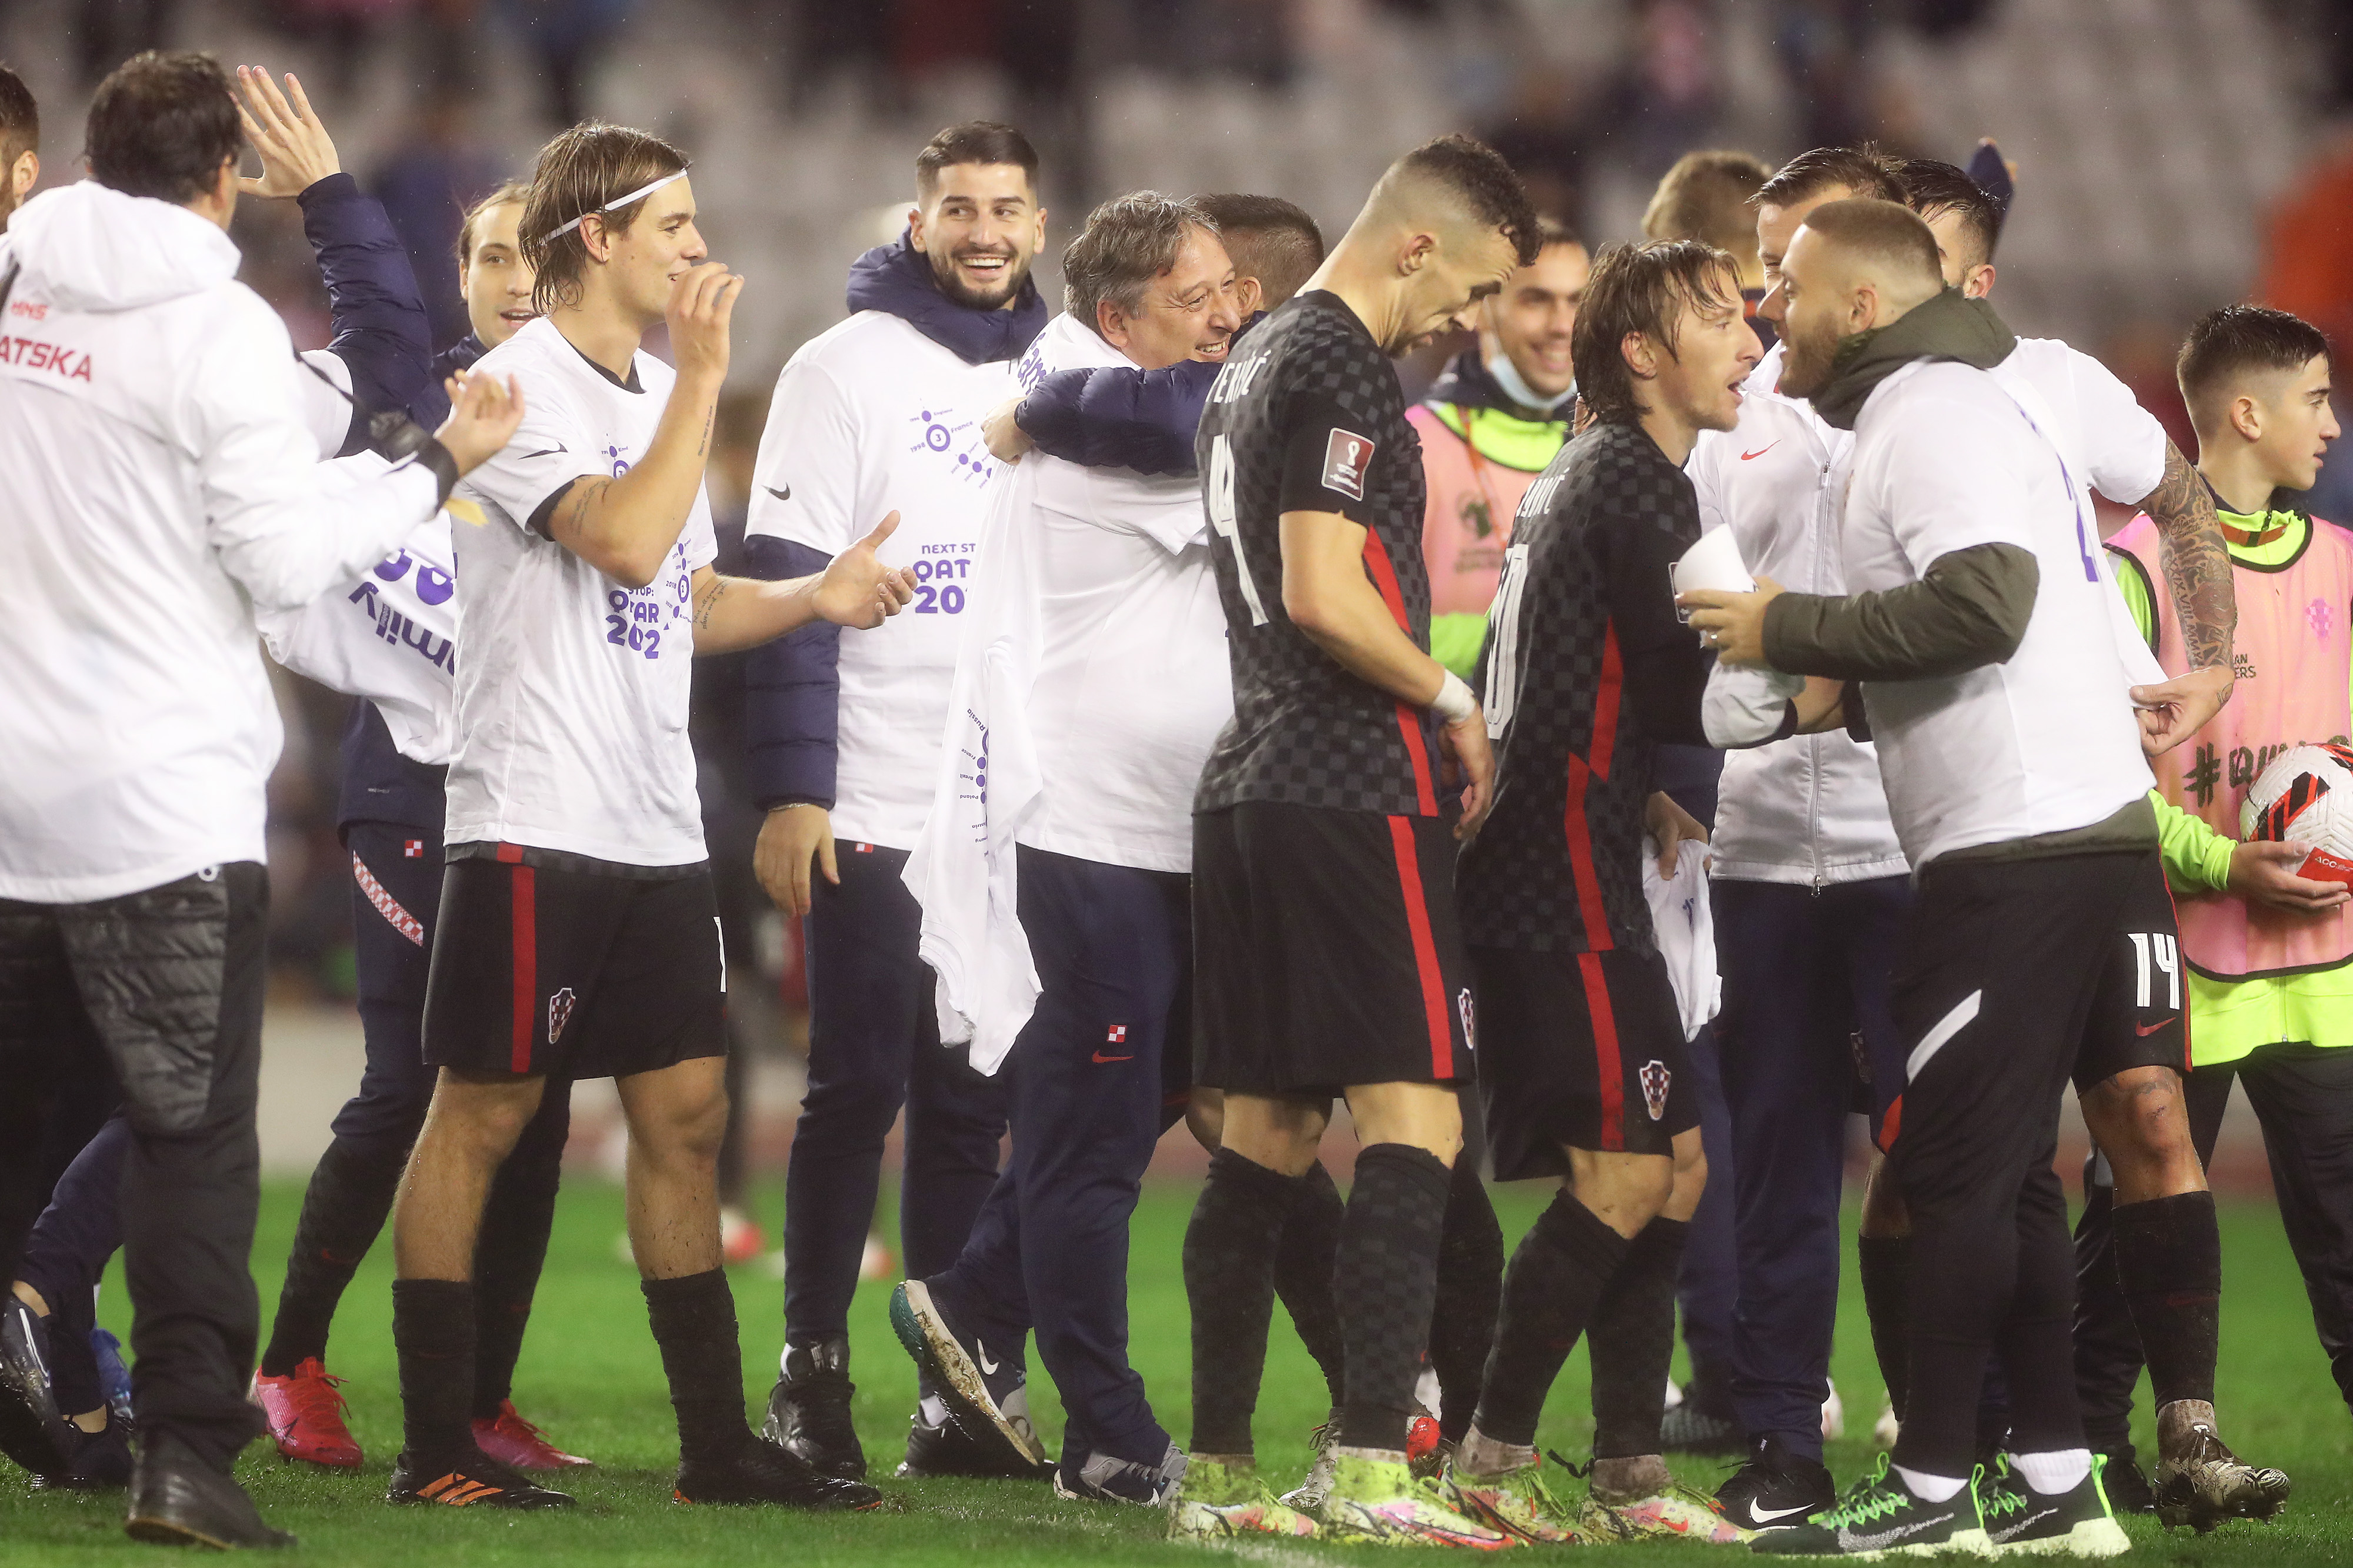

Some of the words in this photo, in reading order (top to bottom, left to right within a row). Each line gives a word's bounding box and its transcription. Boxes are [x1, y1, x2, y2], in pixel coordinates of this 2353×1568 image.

[951, 421, 974, 433] France
[910, 442, 926, 452] 1998
[921, 544, 956, 554] NEXT
[666, 580, 677, 589] 2018
[966, 708, 986, 731] Russia
[961, 748, 976, 760] France
[959, 773, 974, 781] Brazil
[2315, 856, 2337, 868] ACC
[2127, 933, 2180, 1010] 14
